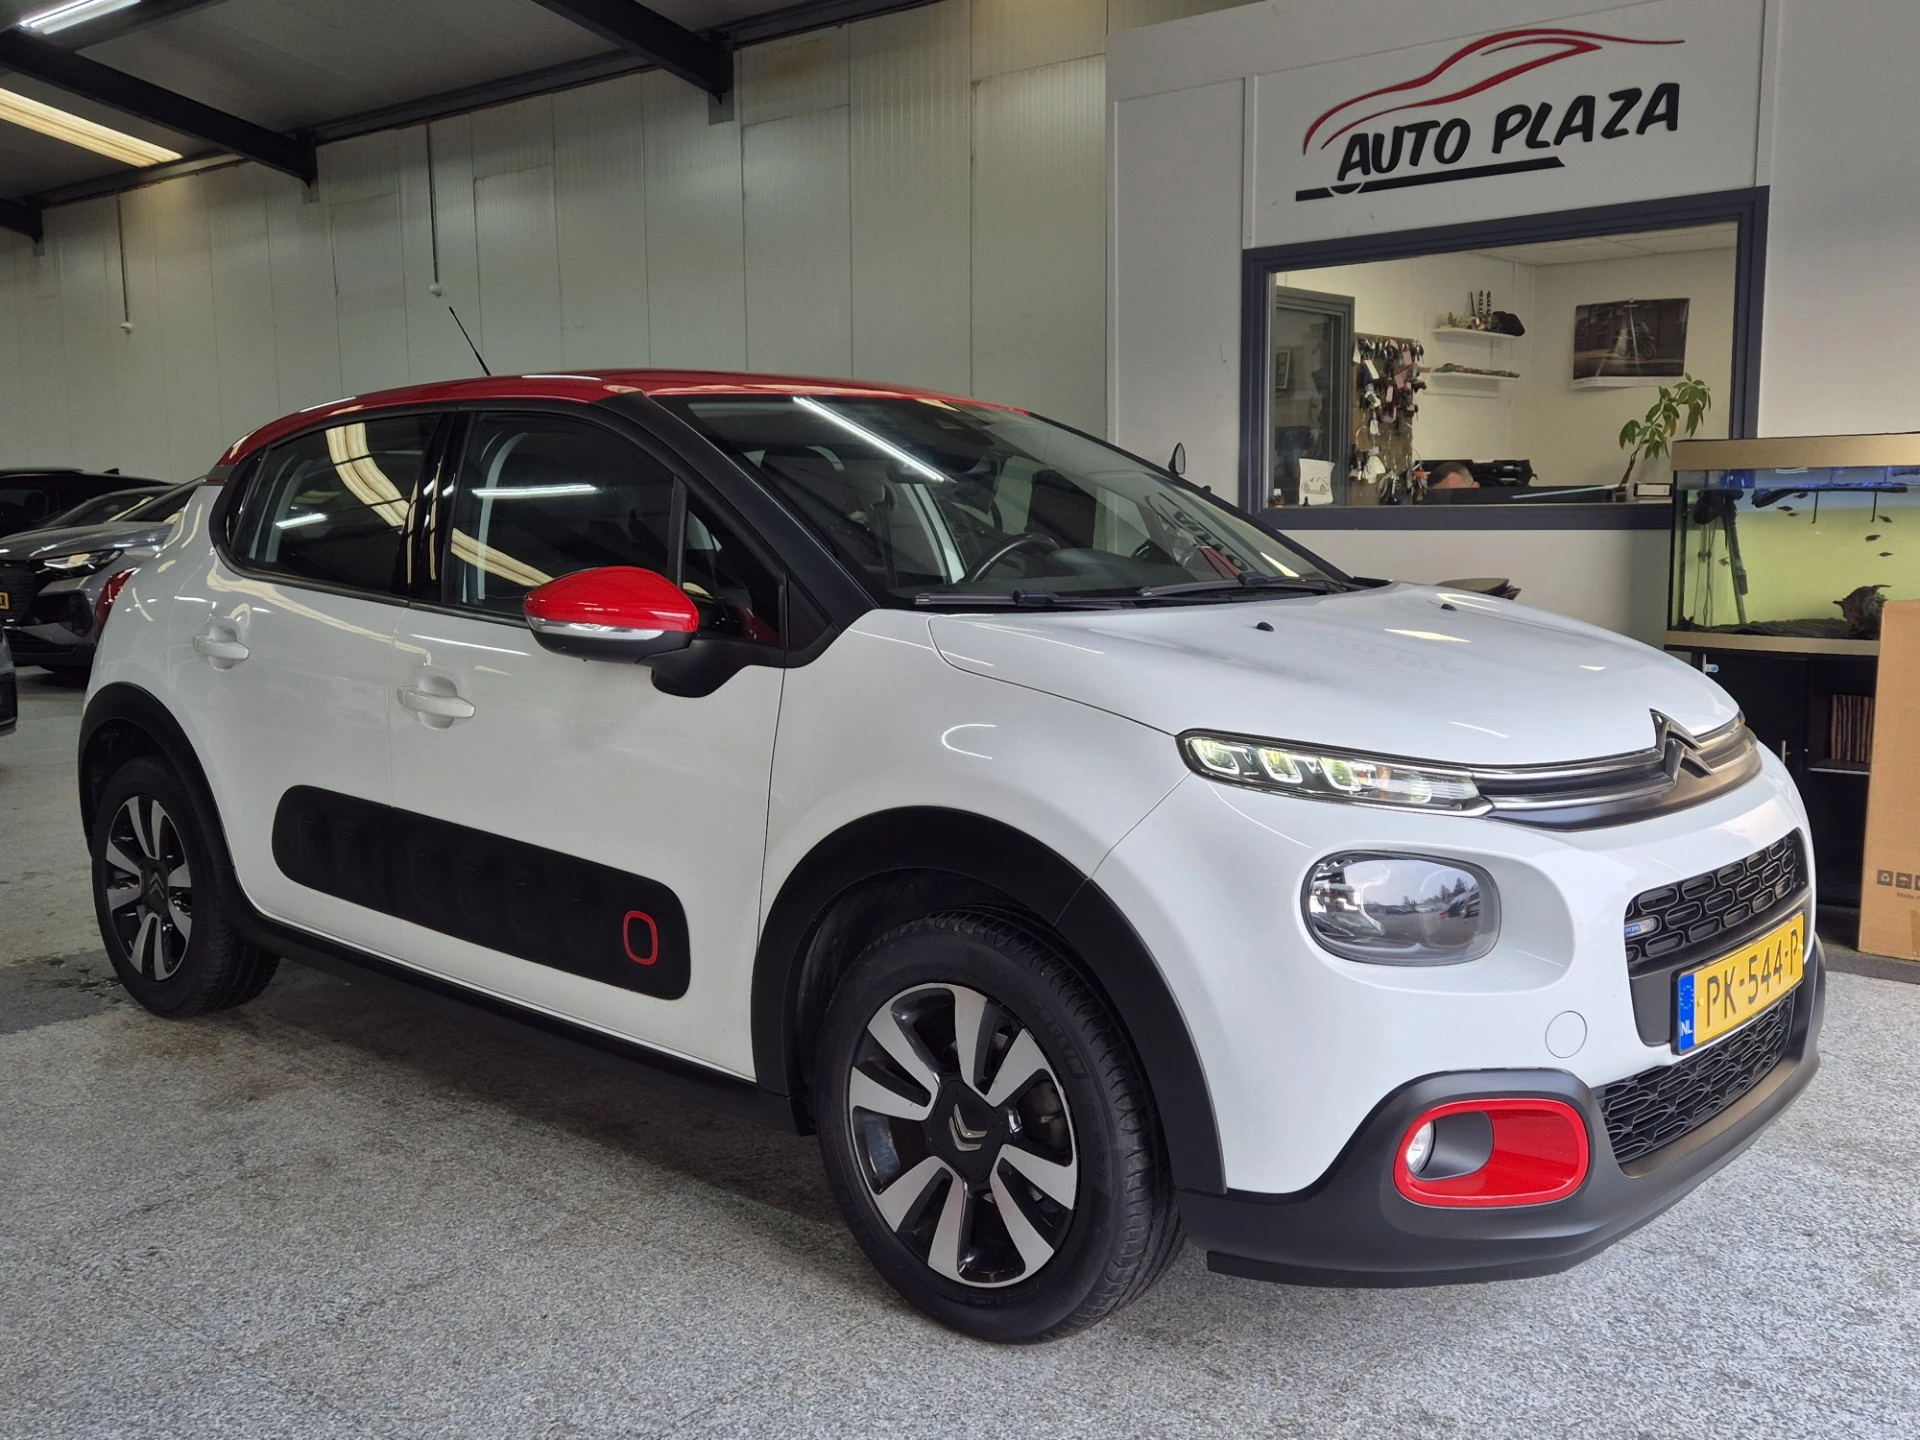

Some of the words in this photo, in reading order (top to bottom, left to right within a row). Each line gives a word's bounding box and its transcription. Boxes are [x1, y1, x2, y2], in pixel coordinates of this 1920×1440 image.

[1337, 118, 1471, 182] AUTO
[1491, 82, 1681, 154] PLAZA
[1706, 928, 1799, 1028] PK-544-P
[1680, 1019, 1693, 1038] NL
